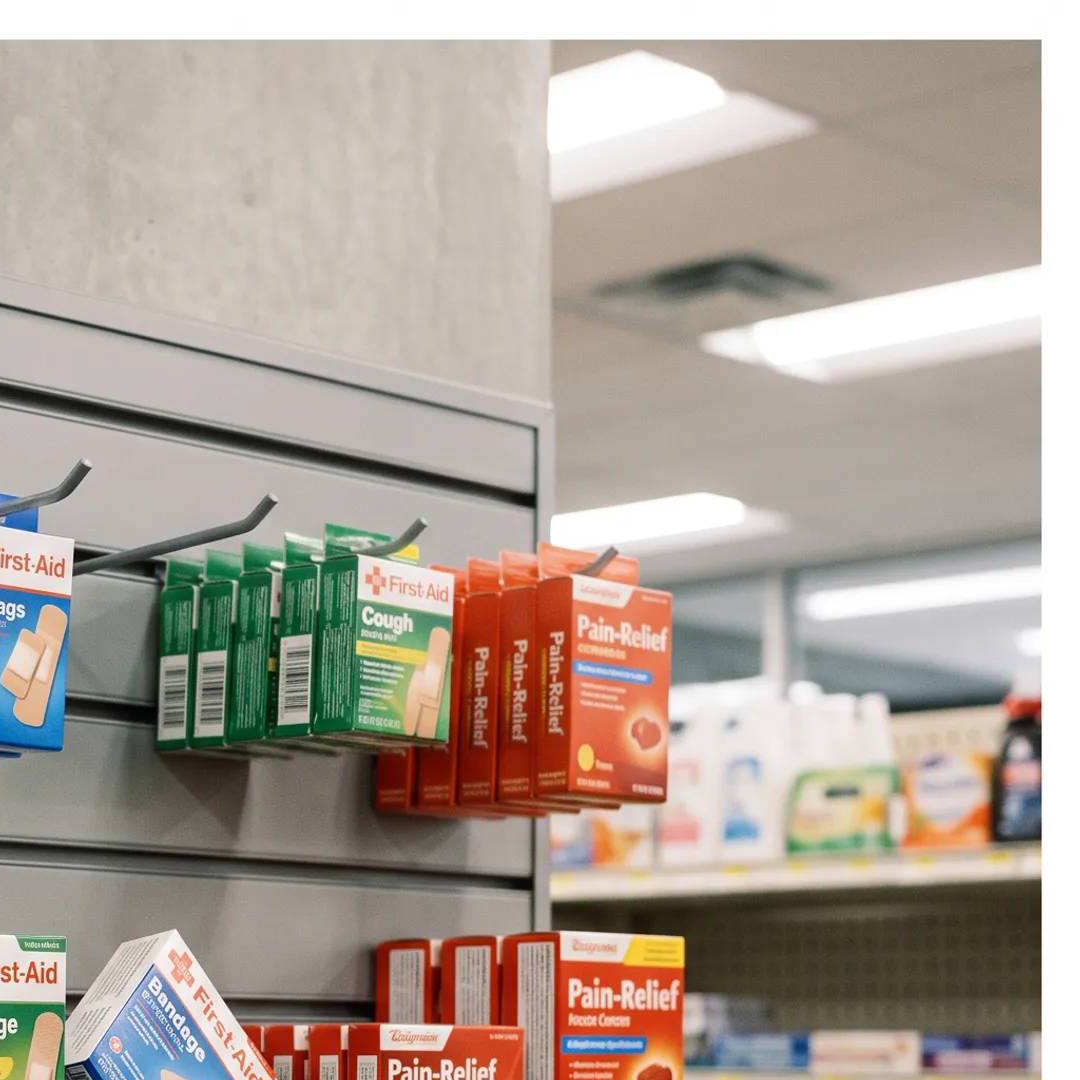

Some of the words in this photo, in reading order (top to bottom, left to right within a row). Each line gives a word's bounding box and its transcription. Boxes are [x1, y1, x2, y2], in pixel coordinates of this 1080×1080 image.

[361, 605, 414, 635] Cough
[577, 613, 668, 654] Pain-Relief
[473, 646, 490, 749] Pain-Relief
[512, 638, 529, 744] Pain-Relief
[548, 630, 565, 736] Pain-Relief
[147, 975, 206, 1063] Bandage
[568, 977, 680, 1011] Pain-Relief
